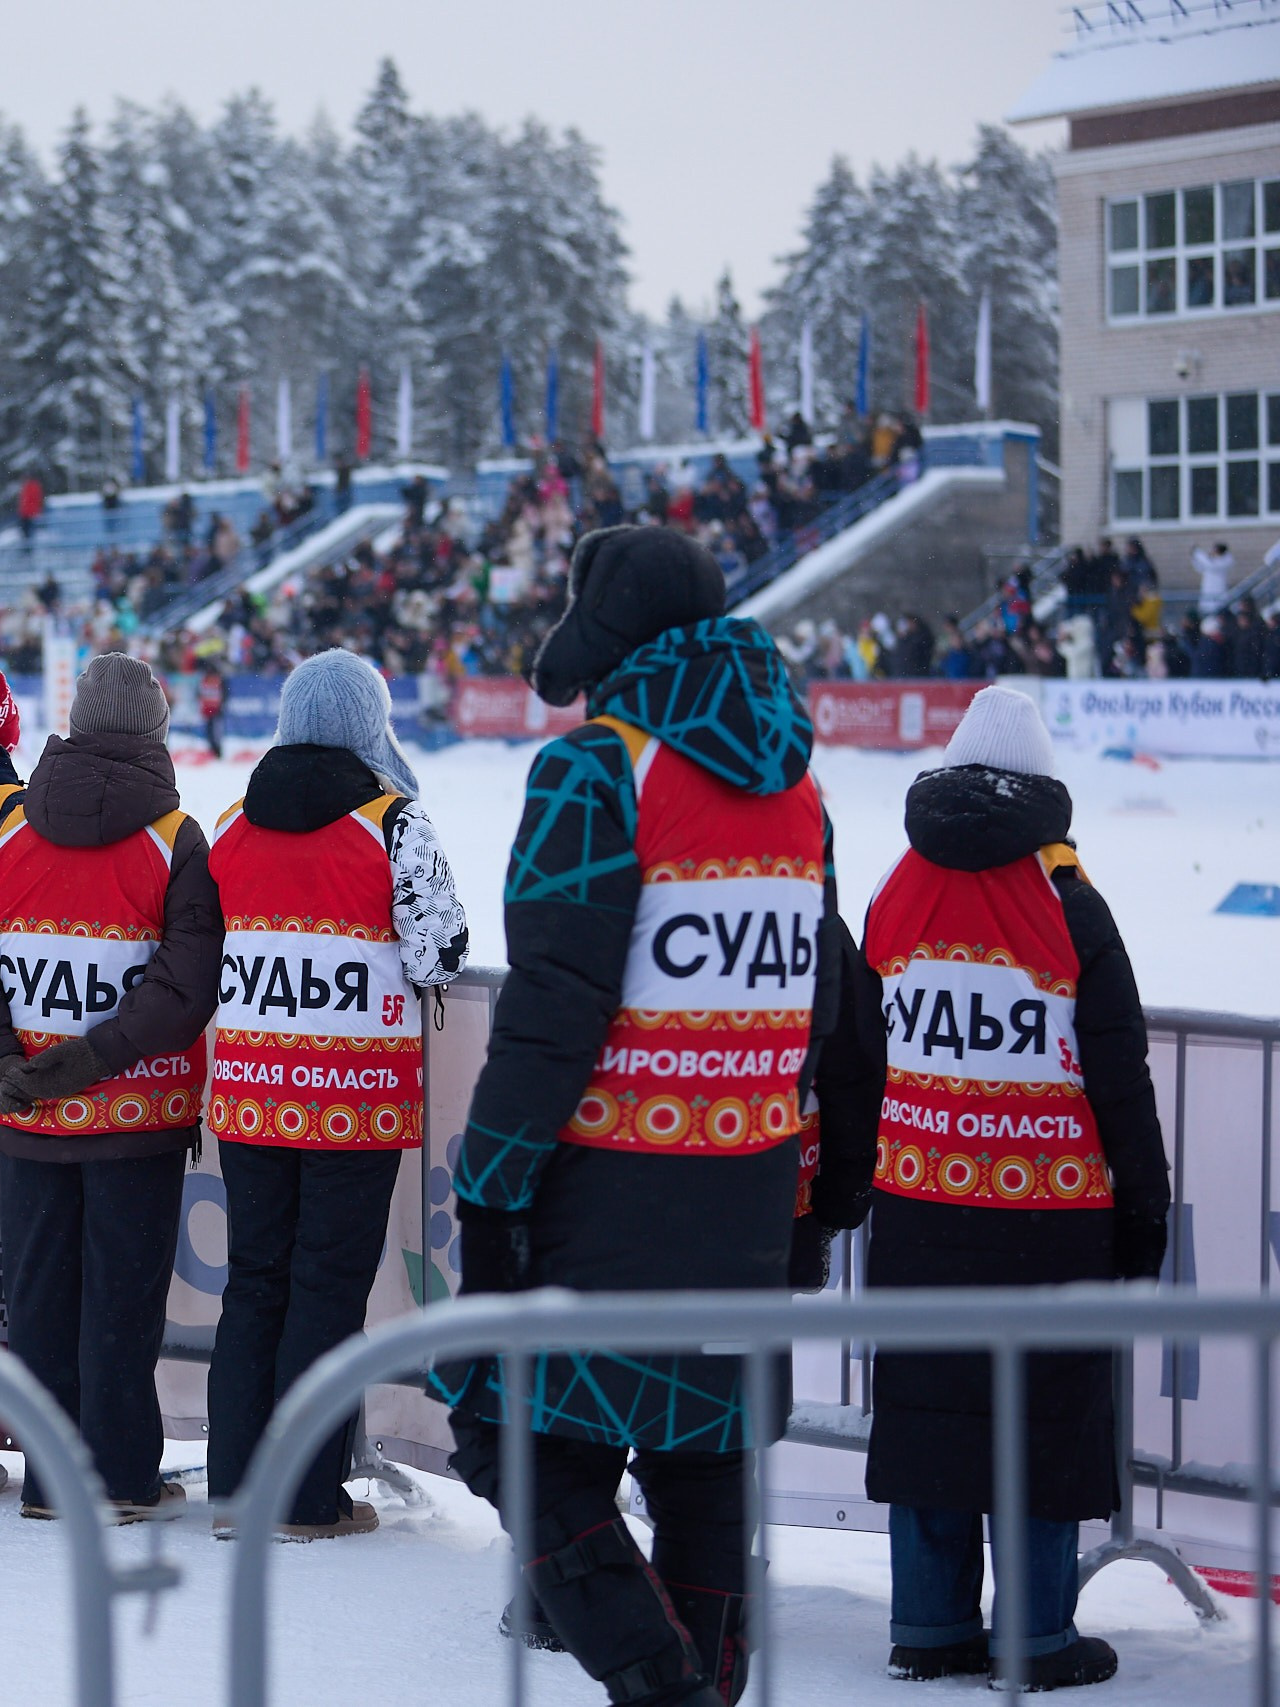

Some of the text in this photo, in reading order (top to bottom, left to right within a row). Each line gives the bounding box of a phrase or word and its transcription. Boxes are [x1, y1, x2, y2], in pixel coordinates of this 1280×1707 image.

[651, 911, 820, 988] СУДЬ
[219, 953, 369, 1018] СУДЬЯ
[382, 995, 405, 1027] 56
[291, 1065, 399, 1089] ОБЛАСТЬ
[594, 1046, 775, 1078] ИРОВСКАЯ
[956, 1113, 1083, 1139] ОБЛАСТЬ
